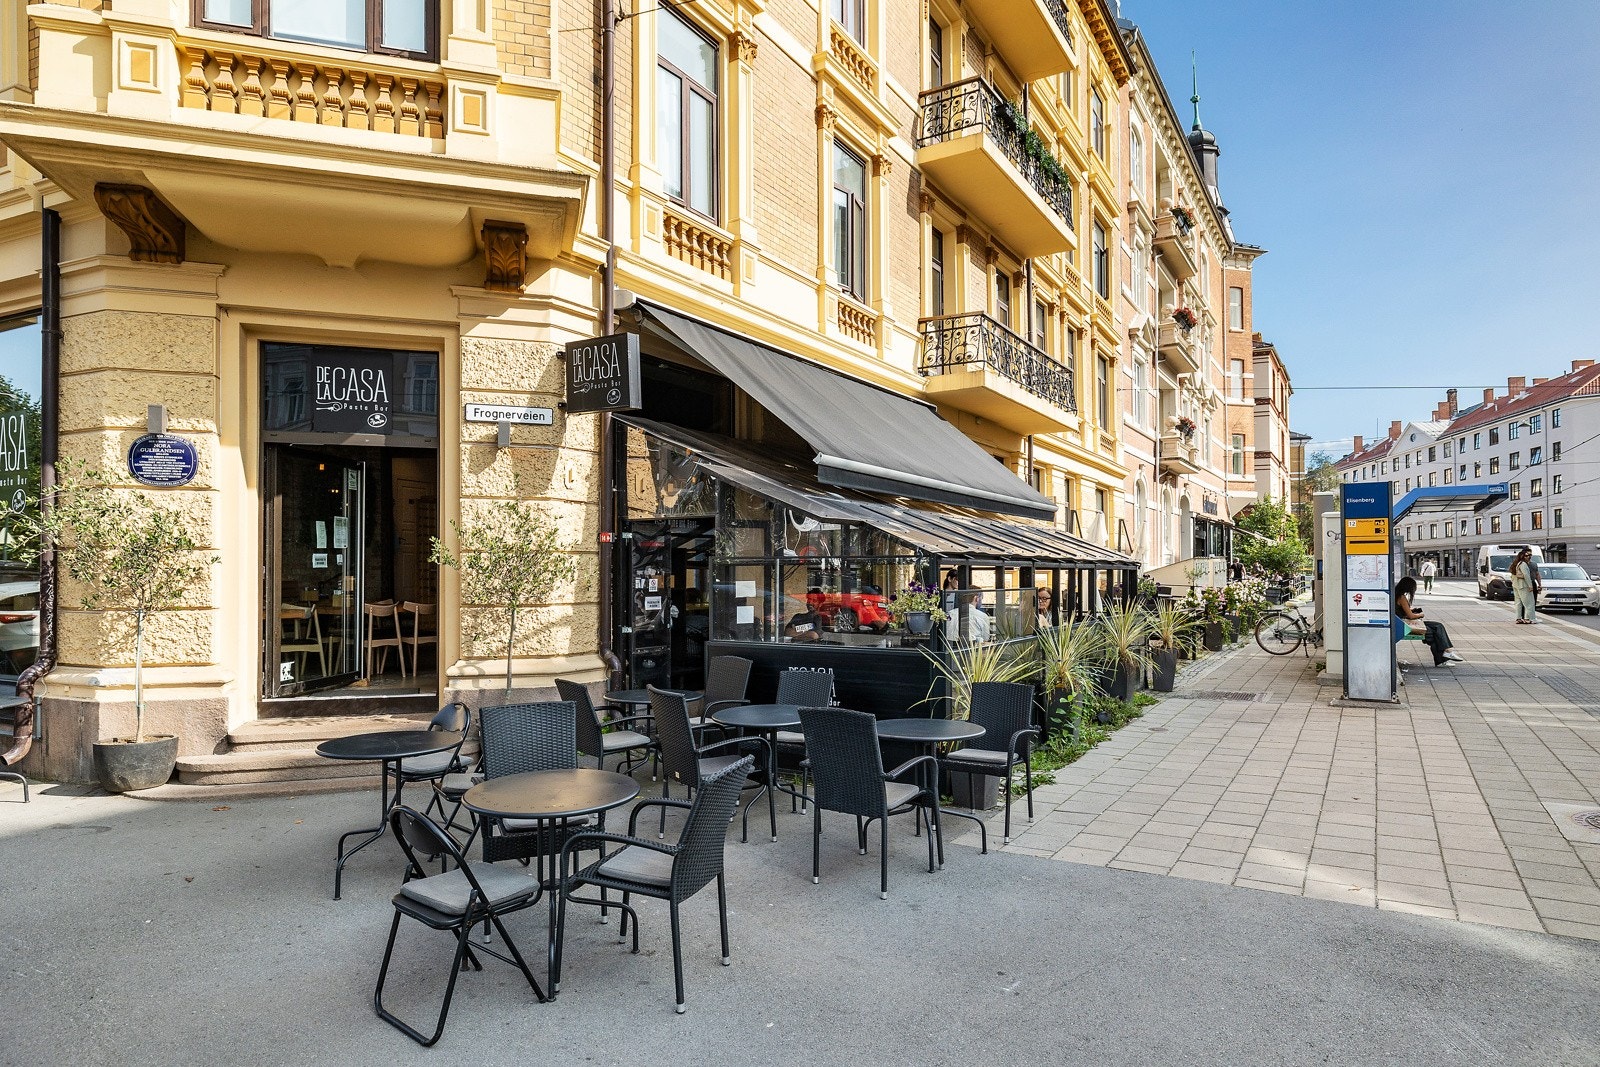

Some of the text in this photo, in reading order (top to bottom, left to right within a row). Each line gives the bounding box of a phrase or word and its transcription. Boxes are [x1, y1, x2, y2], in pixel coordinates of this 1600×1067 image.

[572, 348, 582, 366] DE
[582, 342, 621, 381] CASA
[316, 366, 331, 383] DE
[573, 365, 583, 383] LA
[316, 383, 332, 400] LA
[332, 366, 389, 403] CASA
[343, 402, 389, 412] Pasta Bar
[473, 407, 546, 421] Frognerveien
[0, 414, 28, 472] ASA
[0, 477, 14, 487] asta
